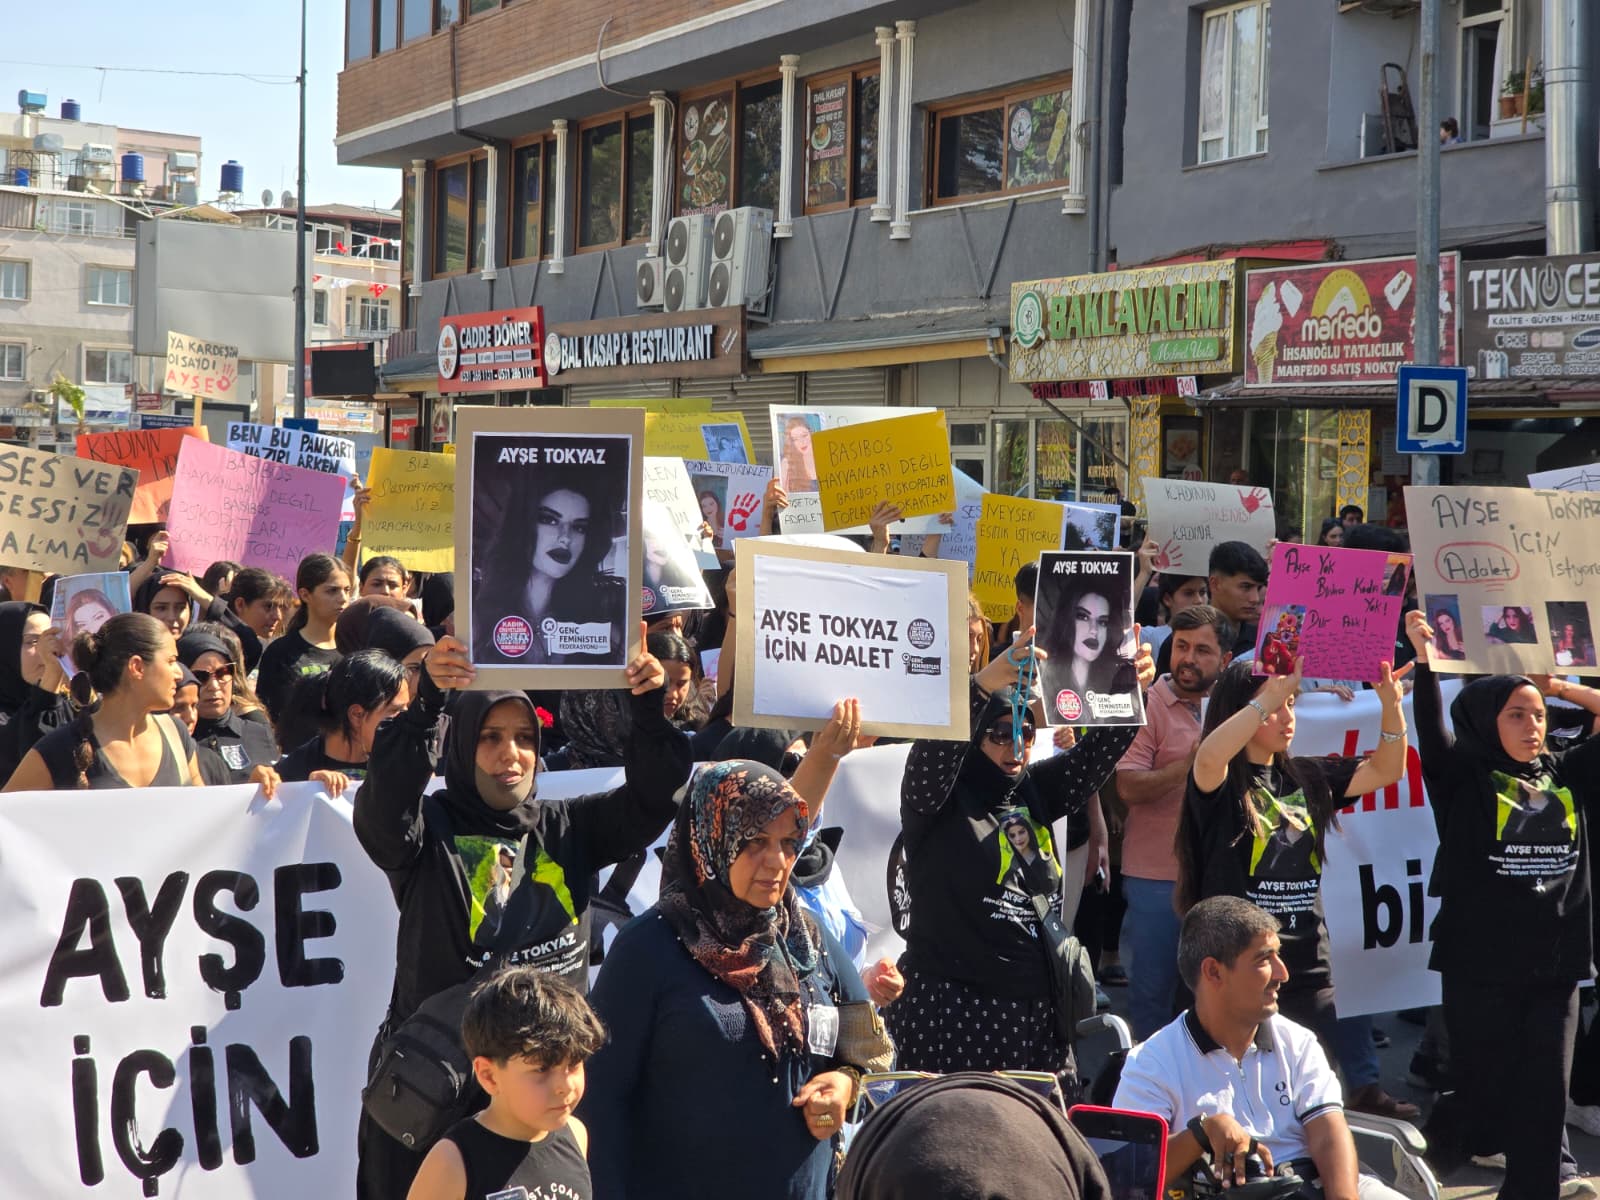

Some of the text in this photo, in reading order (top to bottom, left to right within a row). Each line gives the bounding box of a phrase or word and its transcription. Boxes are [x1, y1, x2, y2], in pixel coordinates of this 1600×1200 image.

[1051, 281, 1220, 340] BAKLAVACIM
[1302, 306, 1382, 341] marfedo
[170, 335, 184, 350] YA
[461, 316, 532, 349] CADDE DÖNER
[561, 325, 713, 370] BAL KASAP & RESTAURANT
[1283, 342, 1404, 361] İHSANOĞLU TATLICILIK
[1277, 363, 1328, 376] MARFEDO
[1330, 363, 1361, 377] SATIŞ
[1418, 387, 1448, 434] D
[230, 424, 262, 442] BEN
[270, 426, 291, 448] BU
[498, 447, 607, 466] AYŞE TOKYAZ
[0, 451, 135, 498] SES VER
[1431, 494, 1499, 528] AYŞE
[1, 531, 89, 565] ALMA
[1053, 561, 1119, 575] AYŞE TOKYAZ
[559, 626, 580, 636] GENÇ
[559, 635, 607, 644] FEMİNİSTLER
[760, 609, 811, 636] AYŞE
[819, 614, 899, 642] TOKYAZ
[765, 634, 894, 669] İÇİN ADALET
[1504, 844, 1570, 855] AYŞE TOKYAZ
[1258, 879, 1319, 893] AYŞE TOKYAZ
[40, 862, 345, 1011] AYŞE
[521, 932, 577, 960] TOKYAZ
[71, 1025, 320, 1198] İÇİN
